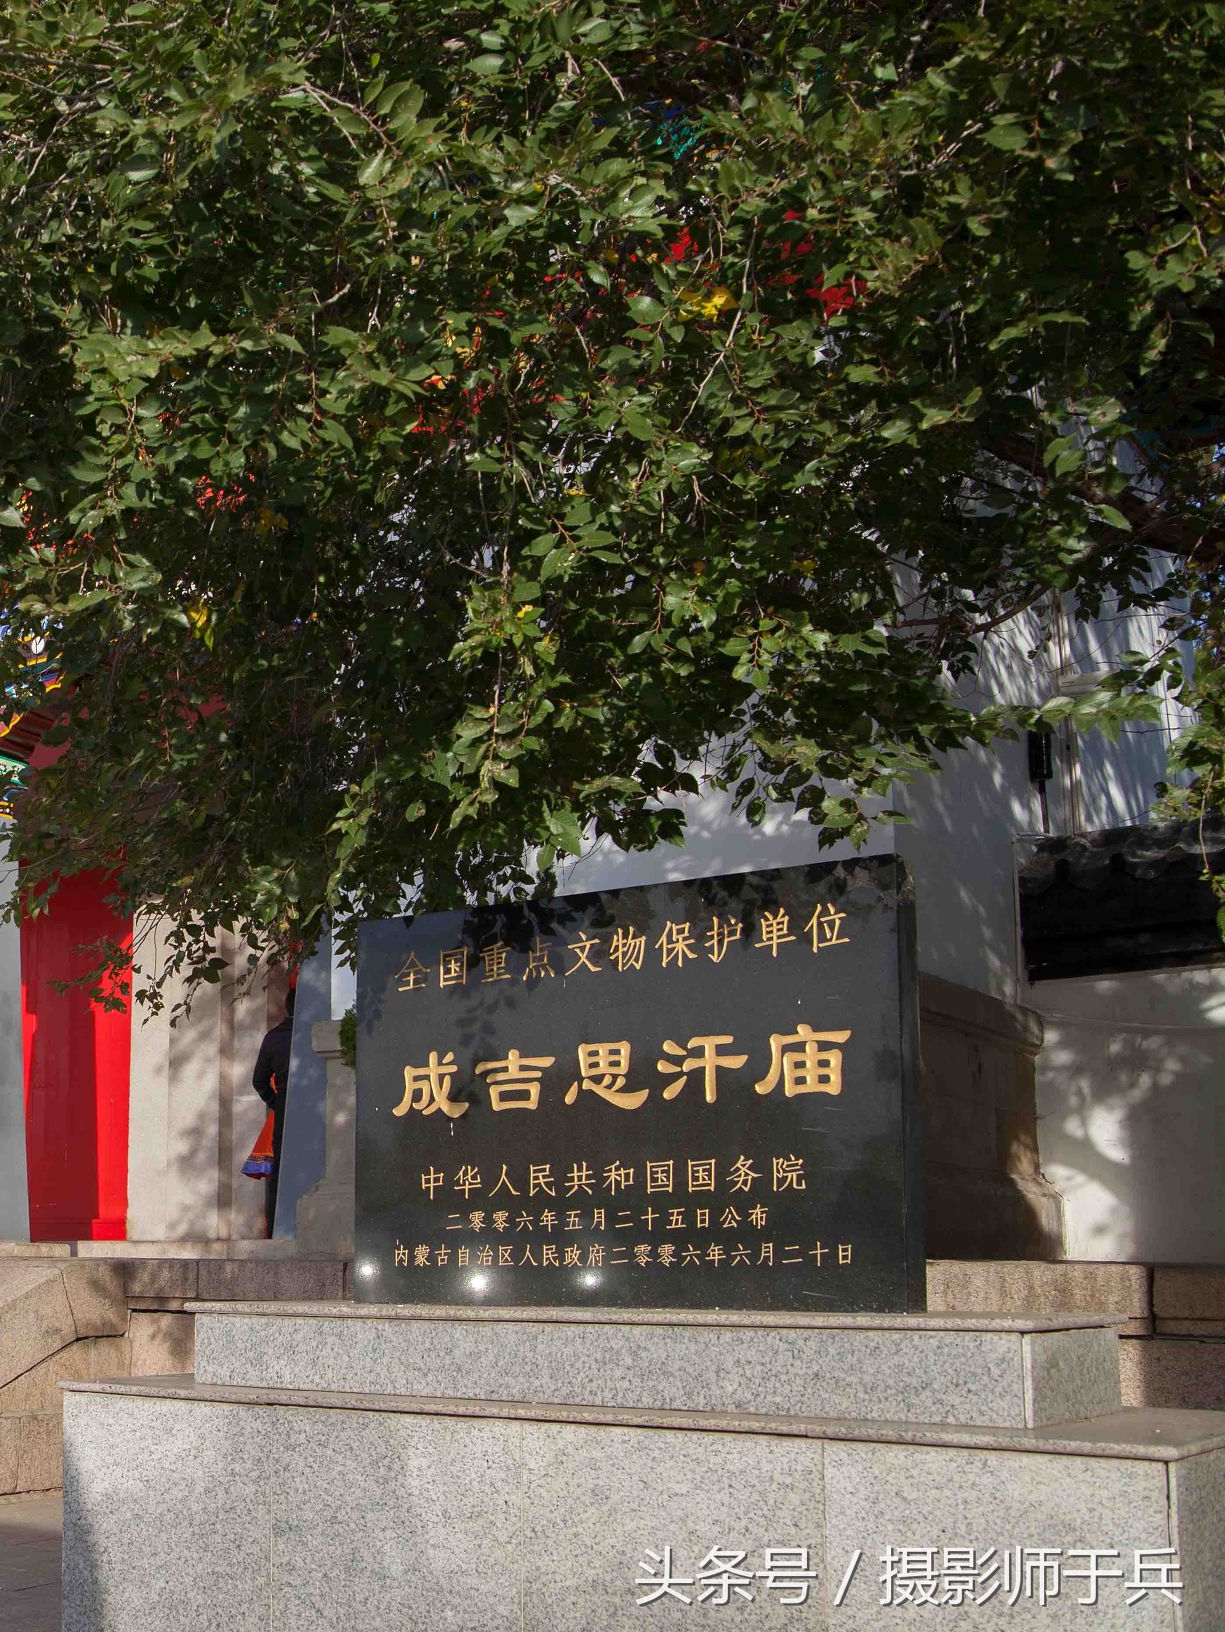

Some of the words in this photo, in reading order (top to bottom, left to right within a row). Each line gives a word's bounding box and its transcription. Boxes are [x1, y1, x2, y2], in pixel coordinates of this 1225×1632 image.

[393, 902, 851, 992] 全国重点文物保护单位
[392, 1023, 852, 1119] 成吉思汗庙
[420, 1154, 806, 1200] 中华人民共和国国务院
[445, 1203, 769, 1233] 二零零六年五月二十五日公布
[393, 1240, 853, 1268] 内蒙古自治区人民政府二零零六年六月二十日
